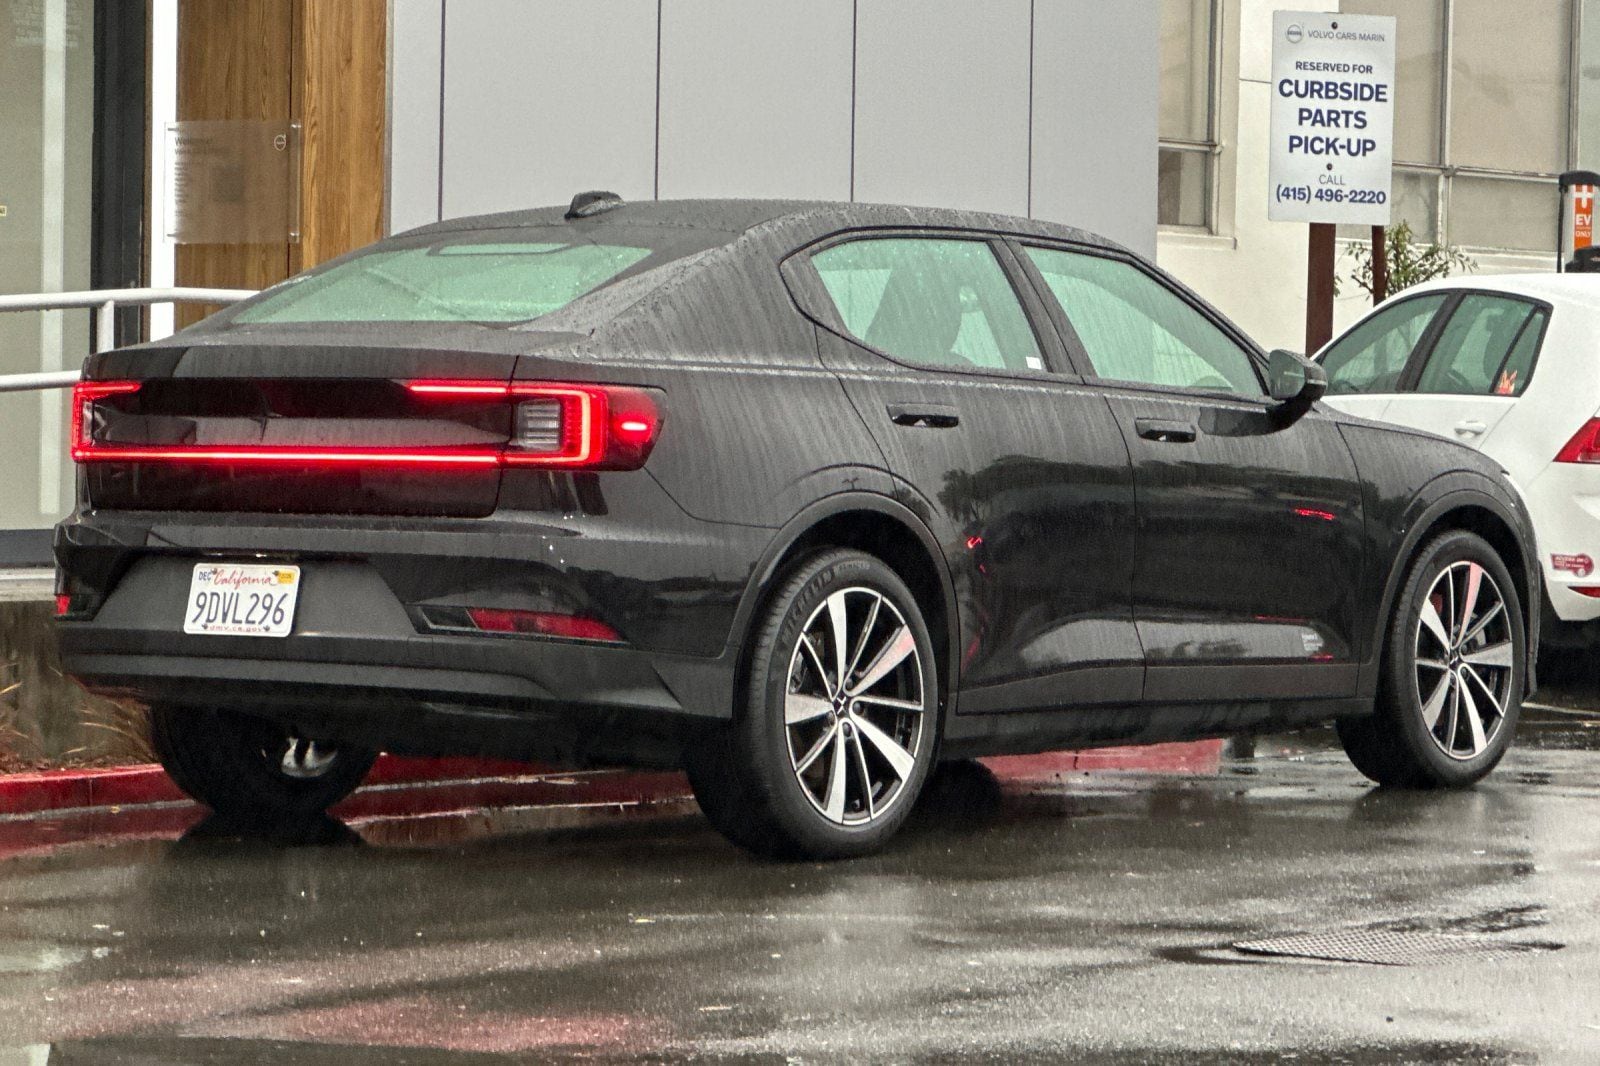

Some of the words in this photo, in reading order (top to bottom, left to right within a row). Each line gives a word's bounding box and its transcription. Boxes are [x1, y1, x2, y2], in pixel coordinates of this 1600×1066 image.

[1308, 30, 1334, 39] VOLVO
[1335, 32, 1357, 40] CARS
[1358, 33, 1385, 41] MARIN
[1295, 61, 1350, 73] RESERVED
[1352, 64, 1373, 74] FOR
[1278, 79, 1388, 102] CURBSIDE
[1298, 107, 1368, 129] PARTS
[1288, 135, 1376, 157] PICK-UP
[1318, 174, 1346, 186] CALL
[1276, 184, 1312, 204] (415)
[1315, 188, 1387, 204] 496-2220
[1575, 213, 1592, 226] EV
[198, 571, 212, 581] DEC
[213, 568, 276, 590] California
[192, 591, 288, 625] 9DVL296
